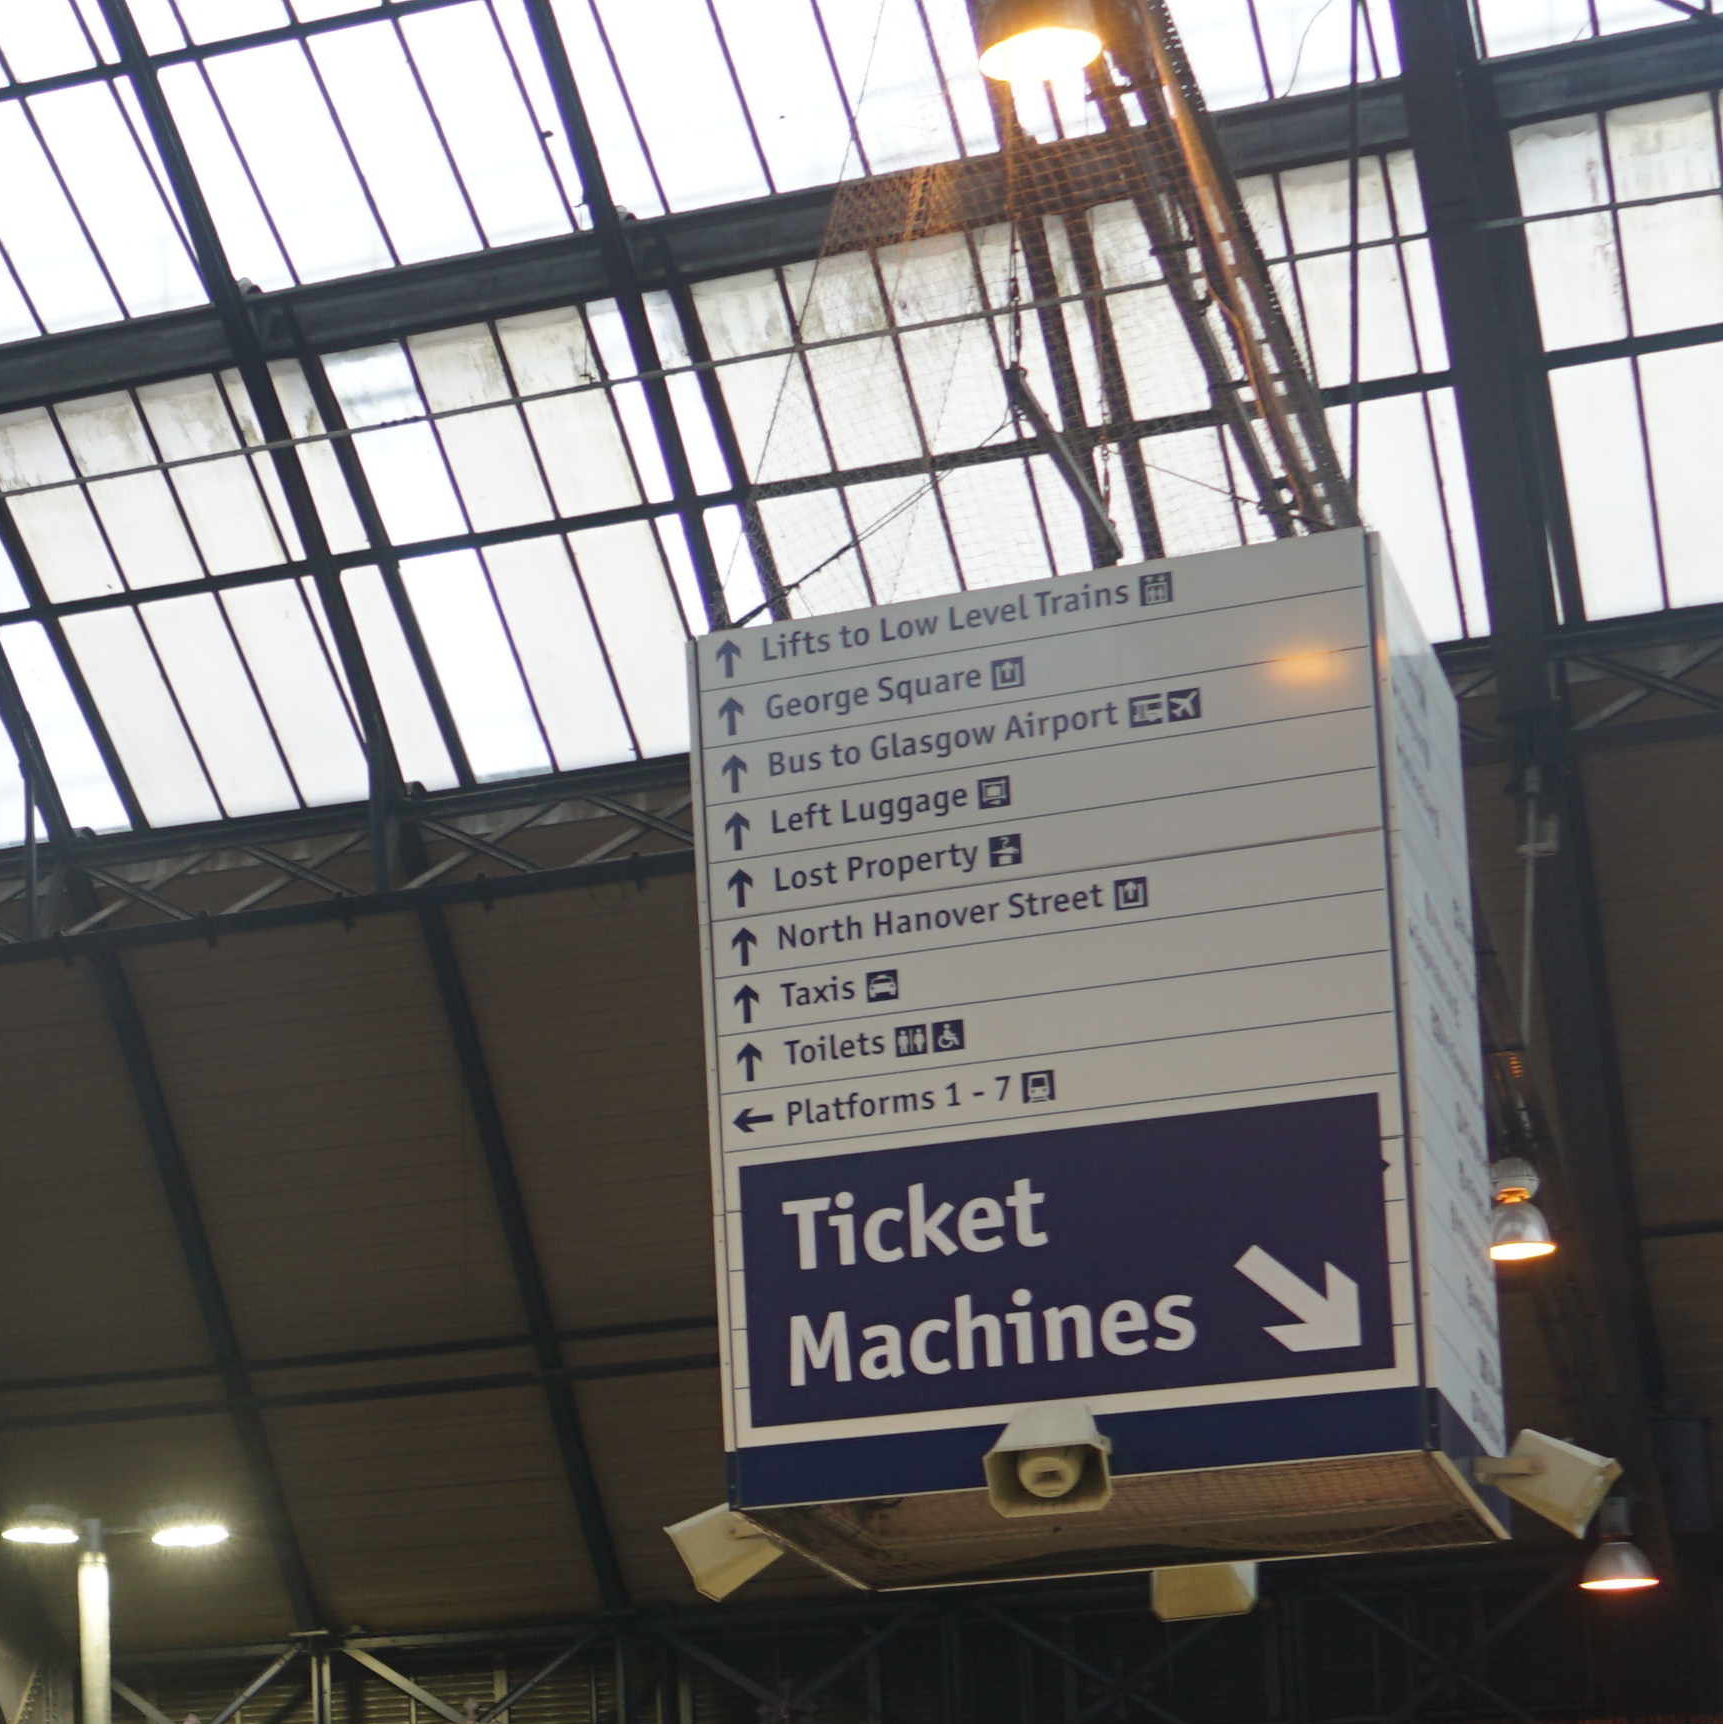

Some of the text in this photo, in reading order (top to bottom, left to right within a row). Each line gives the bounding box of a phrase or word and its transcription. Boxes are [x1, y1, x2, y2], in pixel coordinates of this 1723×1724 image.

[761, 579, 1130, 662] Lifts to Low Level Trains
[765, 663, 983, 722] George Square
[768, 698, 1119, 778] Bus to Glasgow Airport
[770, 783, 969, 835] Left Luggage
[774, 841, 980, 893] Lost Property
[777, 883, 1105, 952] North Hanover Street
[779, 976, 856, 1008] Taxis
[784, 1032, 886, 1066] Toilets
[786, 1075, 1012, 1127] Platforms 1 7
[782, 1177, 1049, 1271] Ticket
[789, 1288, 1198, 1388] Machines
